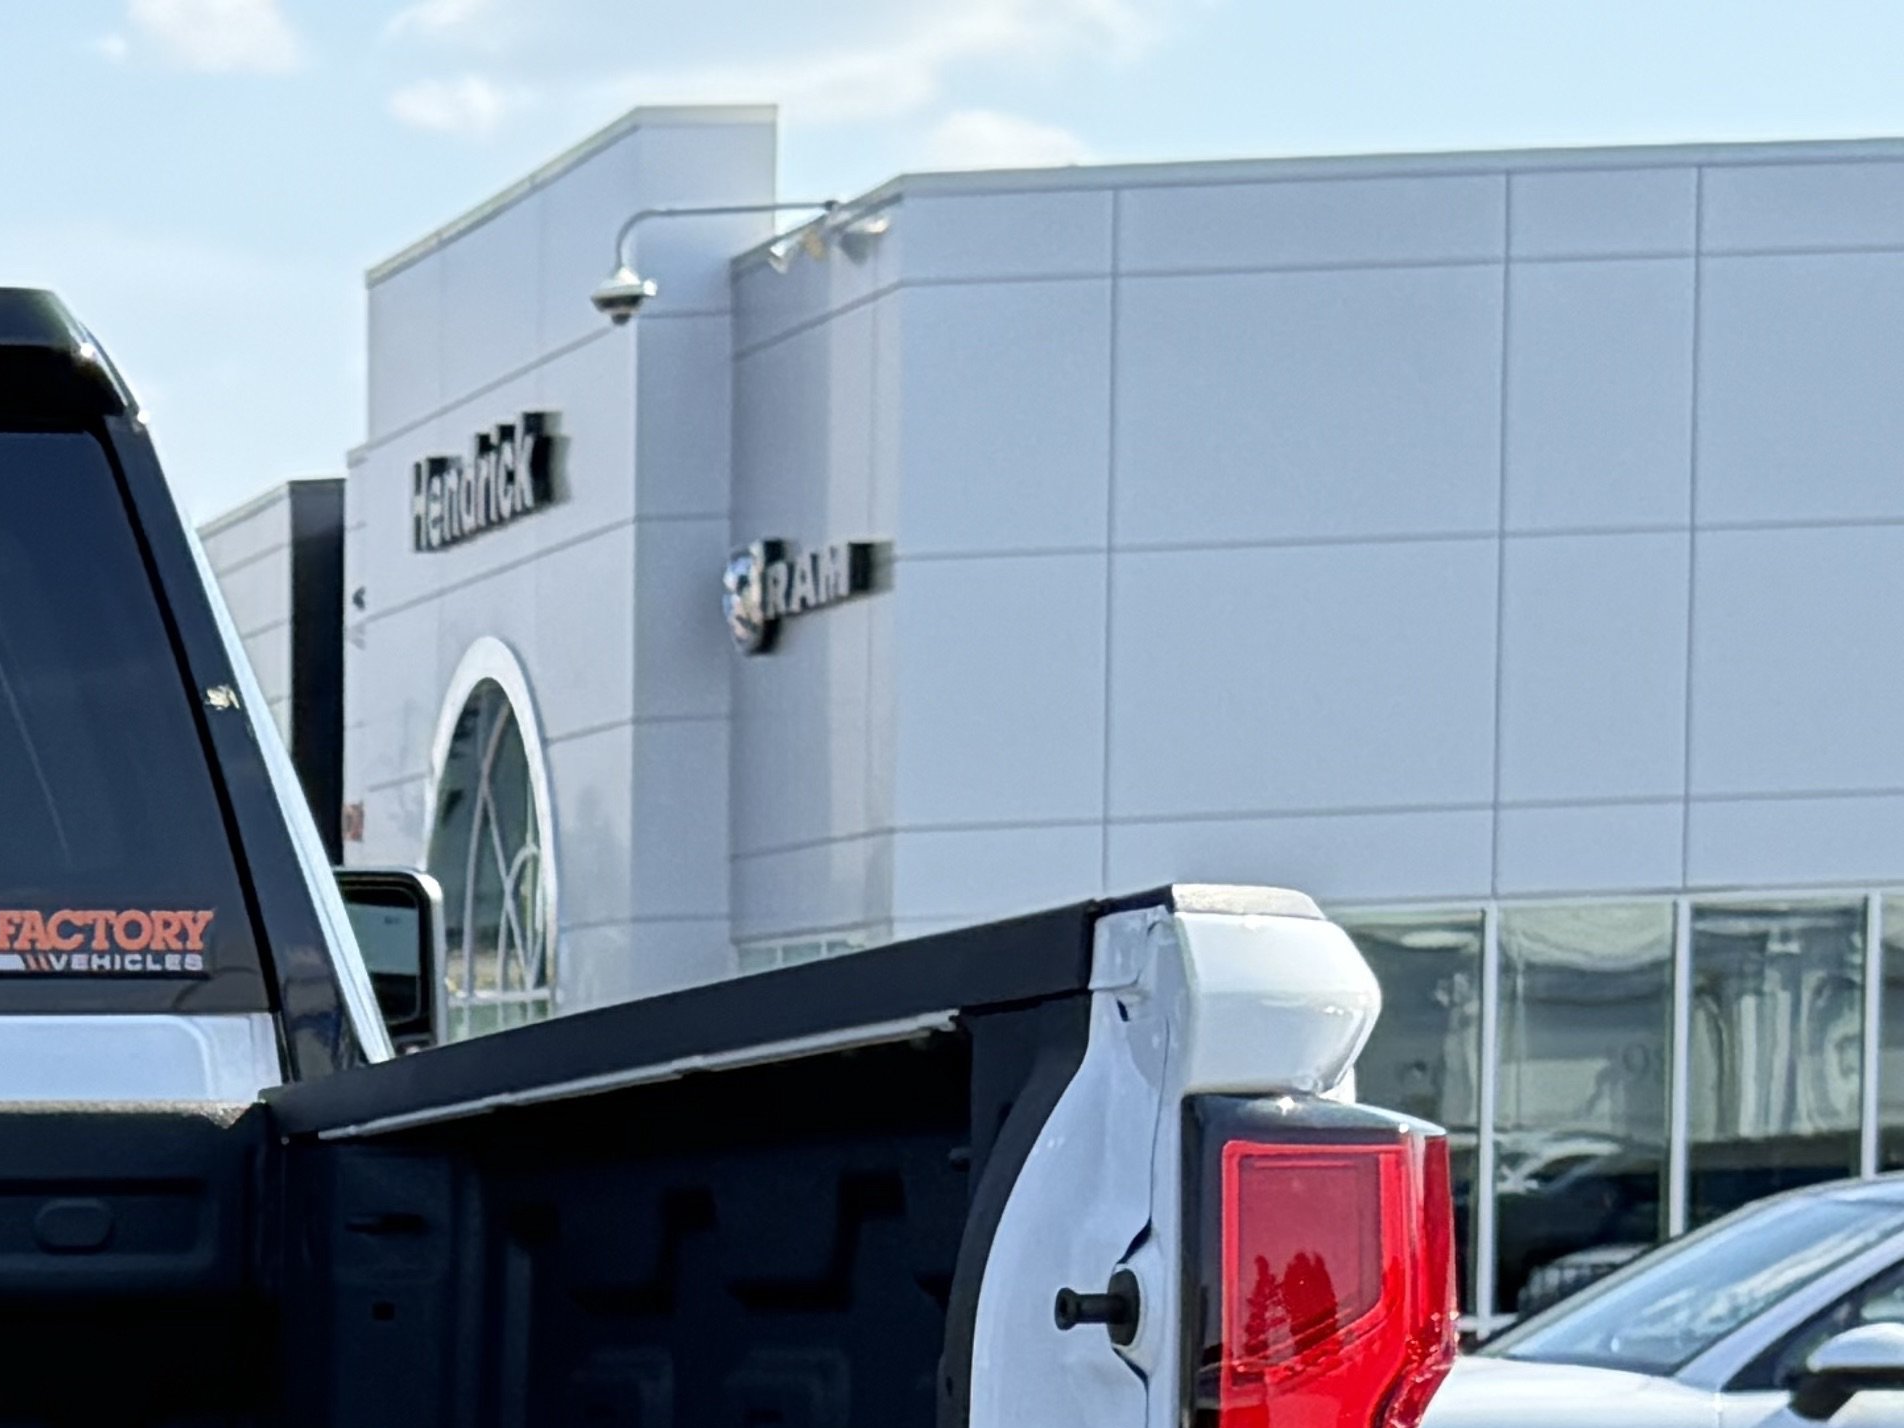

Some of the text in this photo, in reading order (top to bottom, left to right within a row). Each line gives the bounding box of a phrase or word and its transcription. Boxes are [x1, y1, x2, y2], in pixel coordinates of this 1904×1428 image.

[411, 412, 554, 551] Hendrick
[765, 543, 860, 620] RAM
[51, 953, 204, 971] VEHICLES
